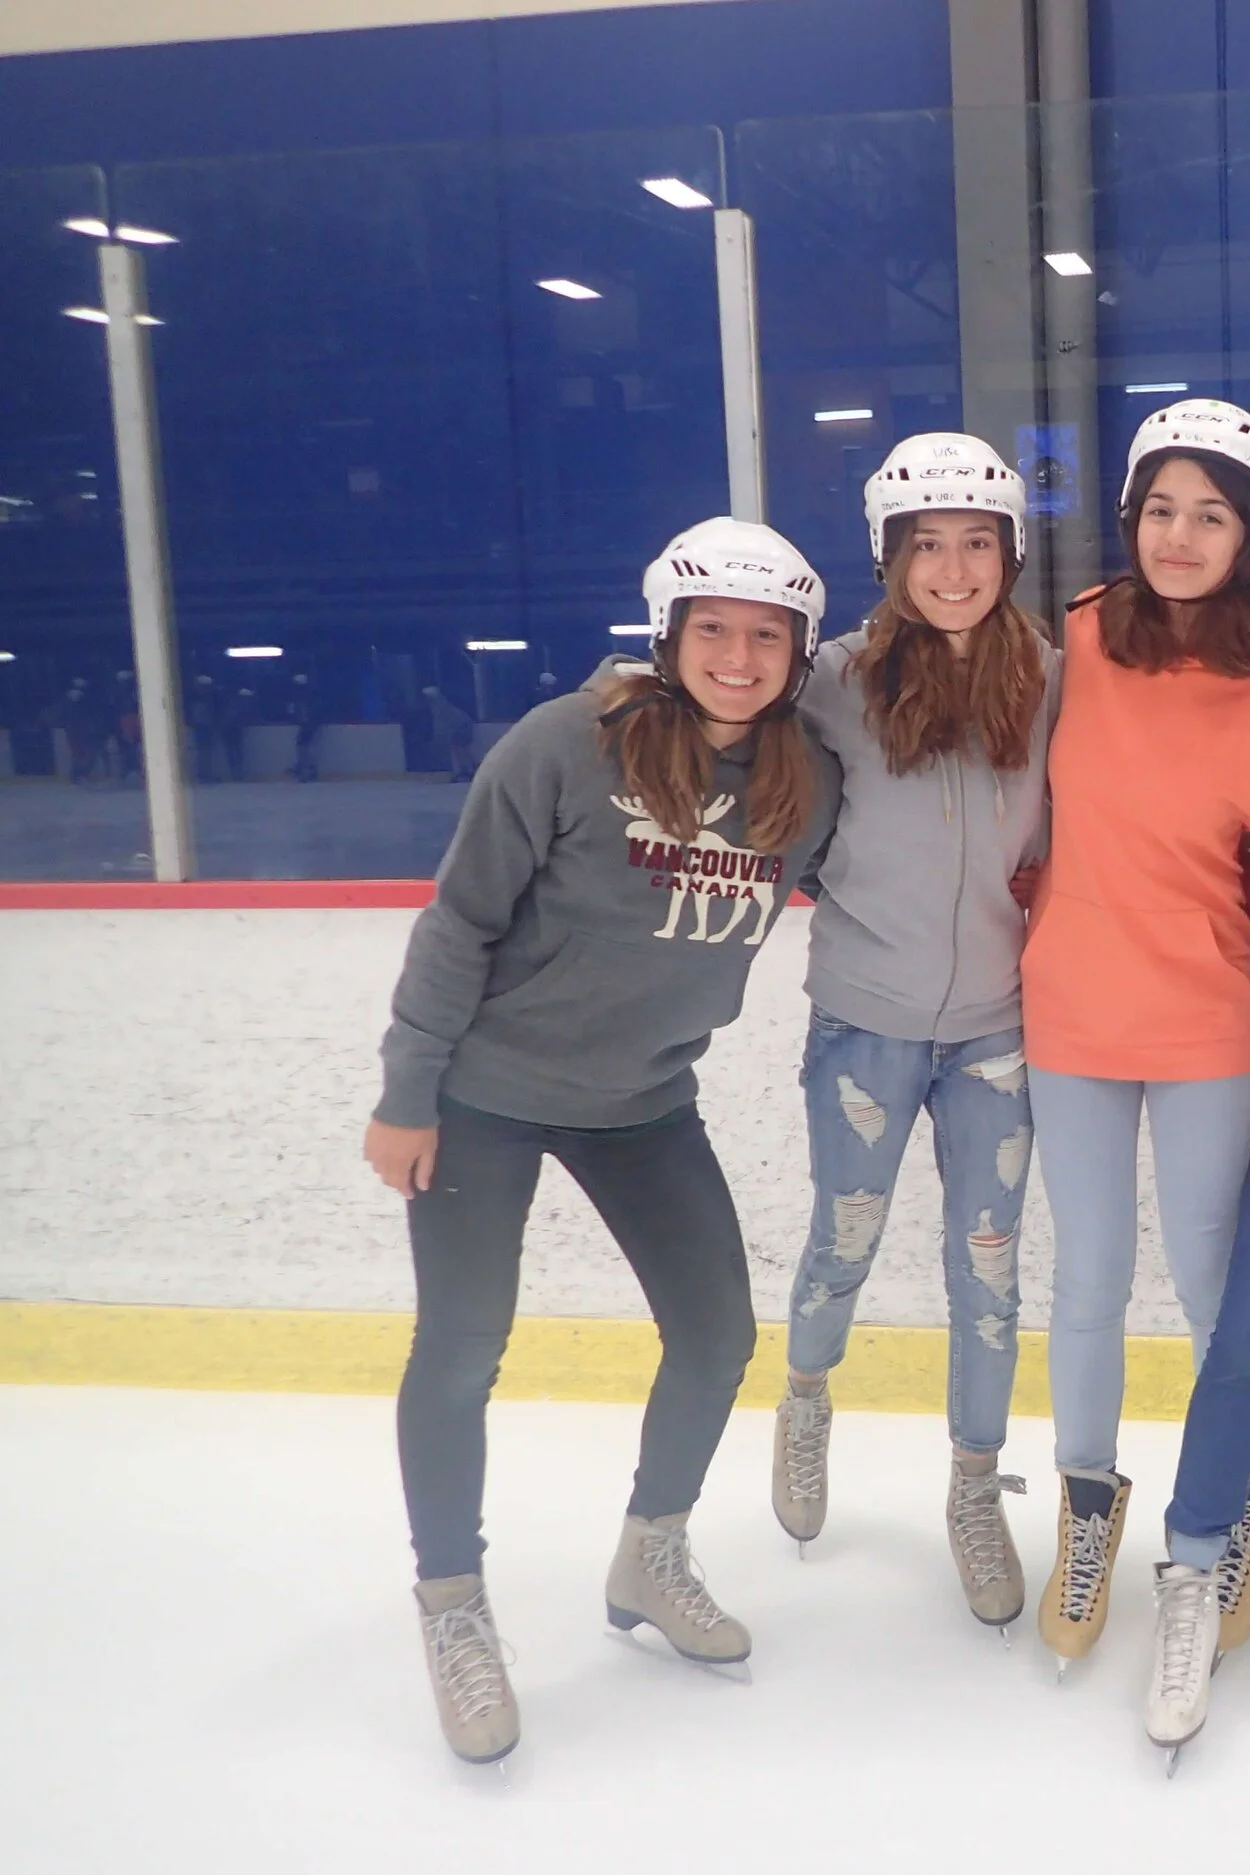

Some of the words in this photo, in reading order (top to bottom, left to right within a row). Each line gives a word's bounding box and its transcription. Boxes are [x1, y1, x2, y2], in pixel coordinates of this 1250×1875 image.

[1180, 412, 1224, 423] CCM
[724, 561, 775, 576] CCM
[650, 874, 756, 900] CANADA
